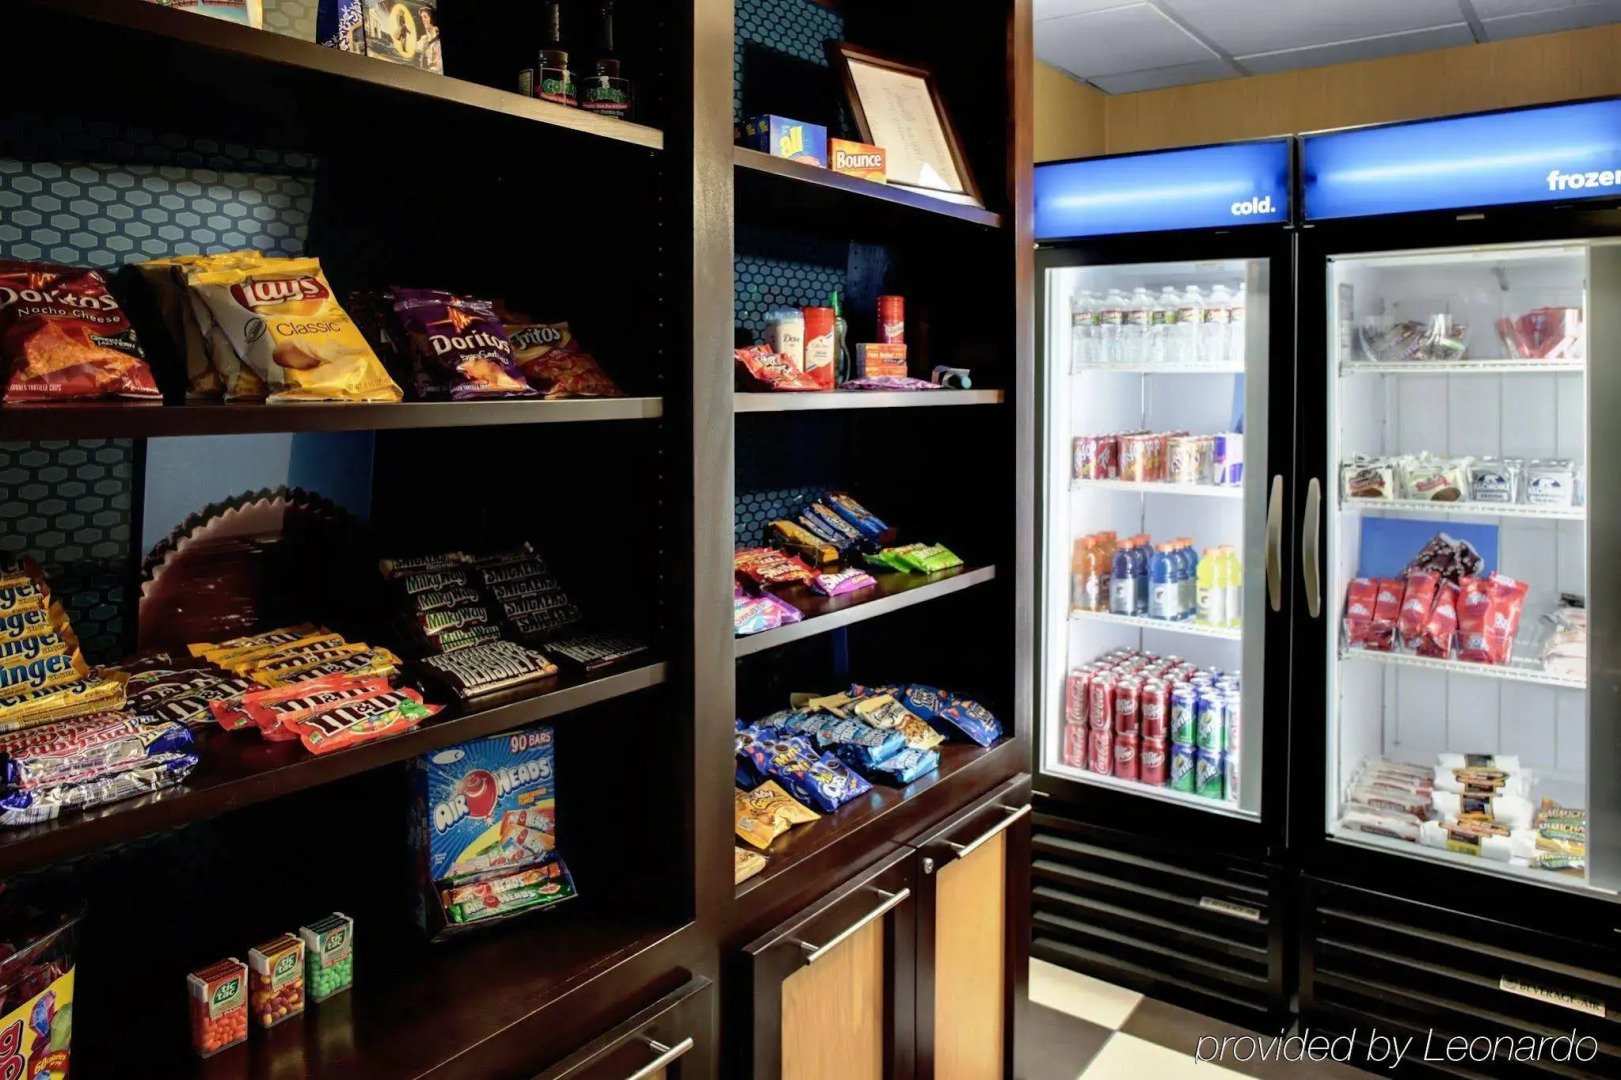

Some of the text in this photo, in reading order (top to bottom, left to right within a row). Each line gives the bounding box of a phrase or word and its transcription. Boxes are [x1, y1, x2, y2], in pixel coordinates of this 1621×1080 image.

[836, 150, 883, 170] Bounce
[1231, 196, 1276, 216] cold.
[18, 307, 120, 323] Nacho Cheese
[276, 320, 341, 337] Classic
[429, 330, 511, 355] Doritos
[511, 733, 551, 753] 90 BARS
[498, 758, 552, 797] HEADS
[278, 960, 296, 973] tac
[281, 953, 296, 965] tic
[216, 988, 236, 1001] tac
[221, 981, 239, 994] tic
